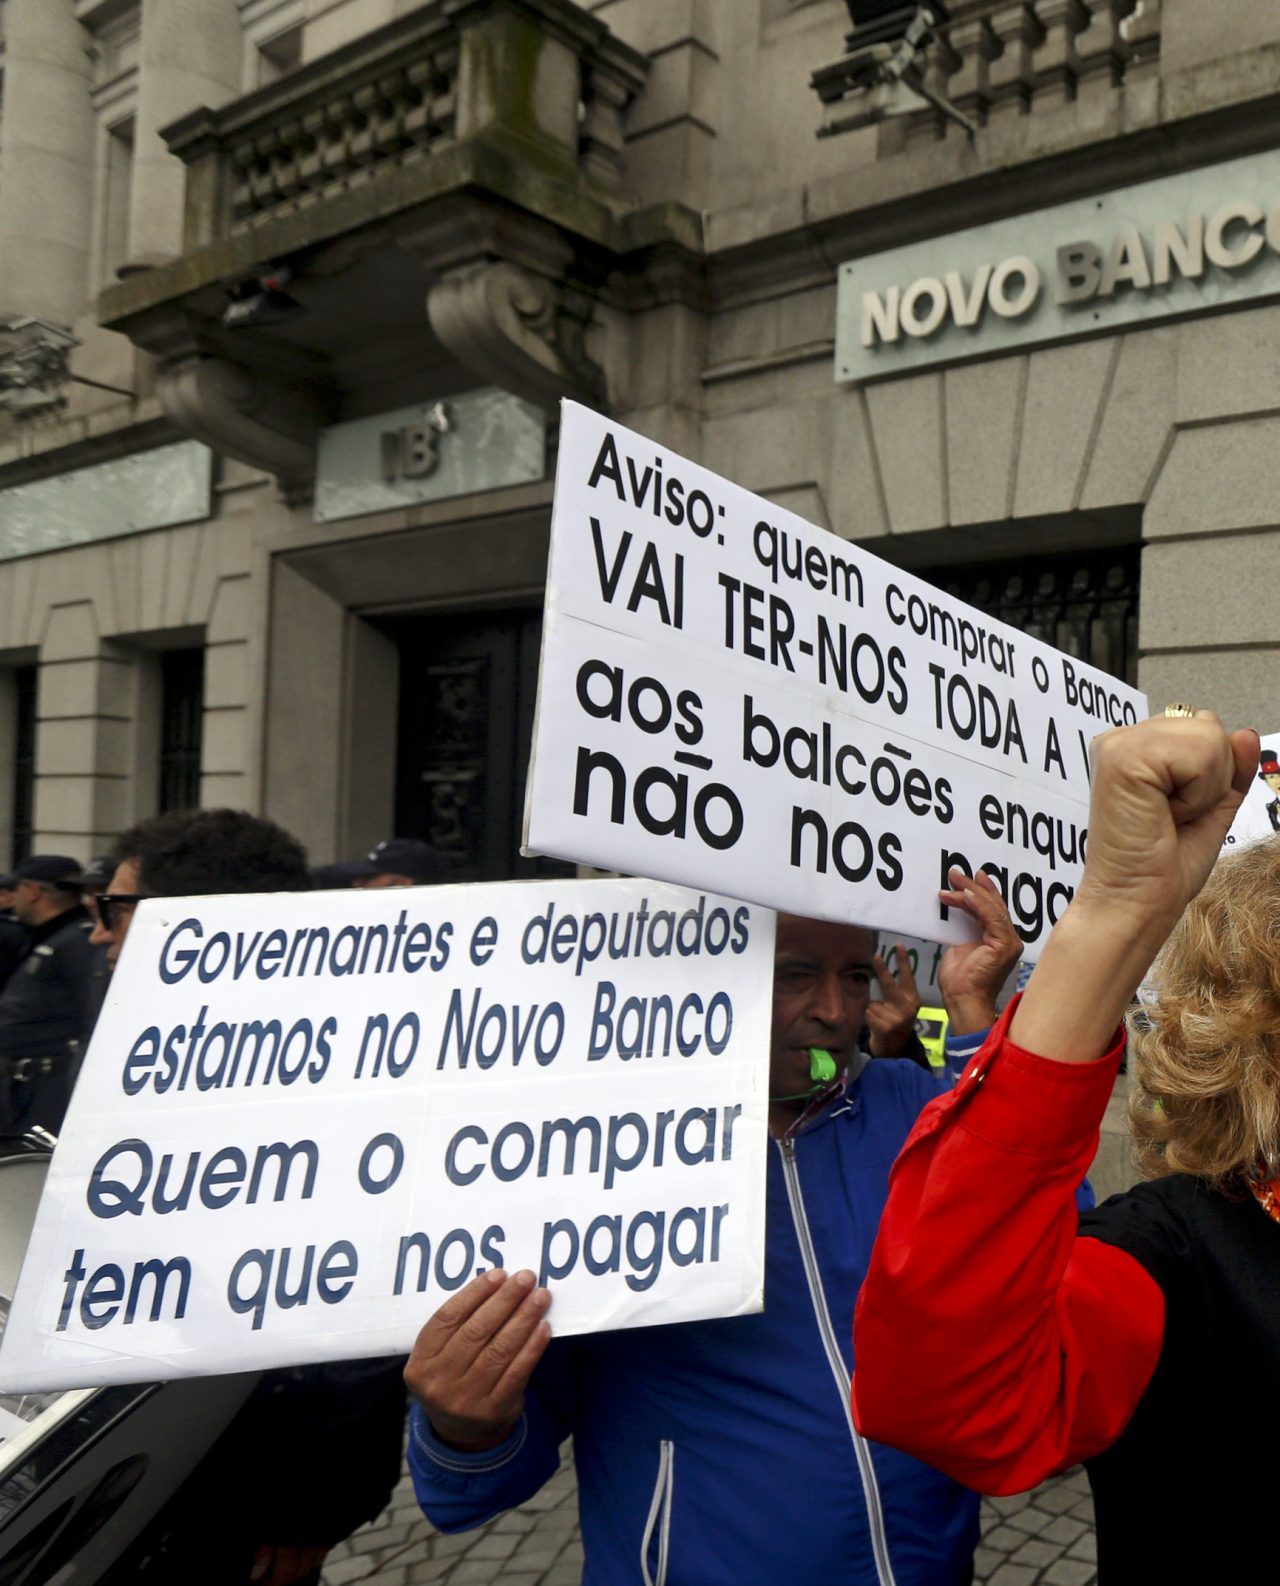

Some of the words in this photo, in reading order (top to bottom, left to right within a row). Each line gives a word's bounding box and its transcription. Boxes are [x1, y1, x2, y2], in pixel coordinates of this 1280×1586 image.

[860, 254, 1042, 348] NOVO
[588, 432, 726, 546] Aviso:
[753, 519, 866, 608] quem
[885, 582, 1016, 679] comprar
[1032, 656, 1049, 694] o
[1062, 658, 1138, 728] Banco
[589, 516, 685, 630] VAI
[718, 572, 909, 715] TER-NOS
[929, 661, 1028, 764] TODA
[1044, 716, 1067, 780] A
[576, 658, 704, 747] aos
[743, 694, 954, 825] balcões
[572, 745, 745, 852] não
[789, 805, 904, 893] nos
[158, 910, 453, 985] Governantes
[470, 916, 498, 965] e
[520, 896, 750, 977] deputados
[121, 1006, 338, 1096] estamos
[353, 1011, 420, 1079] no
[435, 987, 566, 1070] Novo
[586, 980, 733, 1062] Banco
[86, 1137, 320, 1219] Quem
[358, 1131, 404, 1195] o
[444, 1102, 742, 1190] comprar
[55, 1248, 192, 1332] tem
[226, 1239, 359, 1331] que
[392, 1223, 506, 1296] nos
[538, 1203, 730, 1293] pagar
